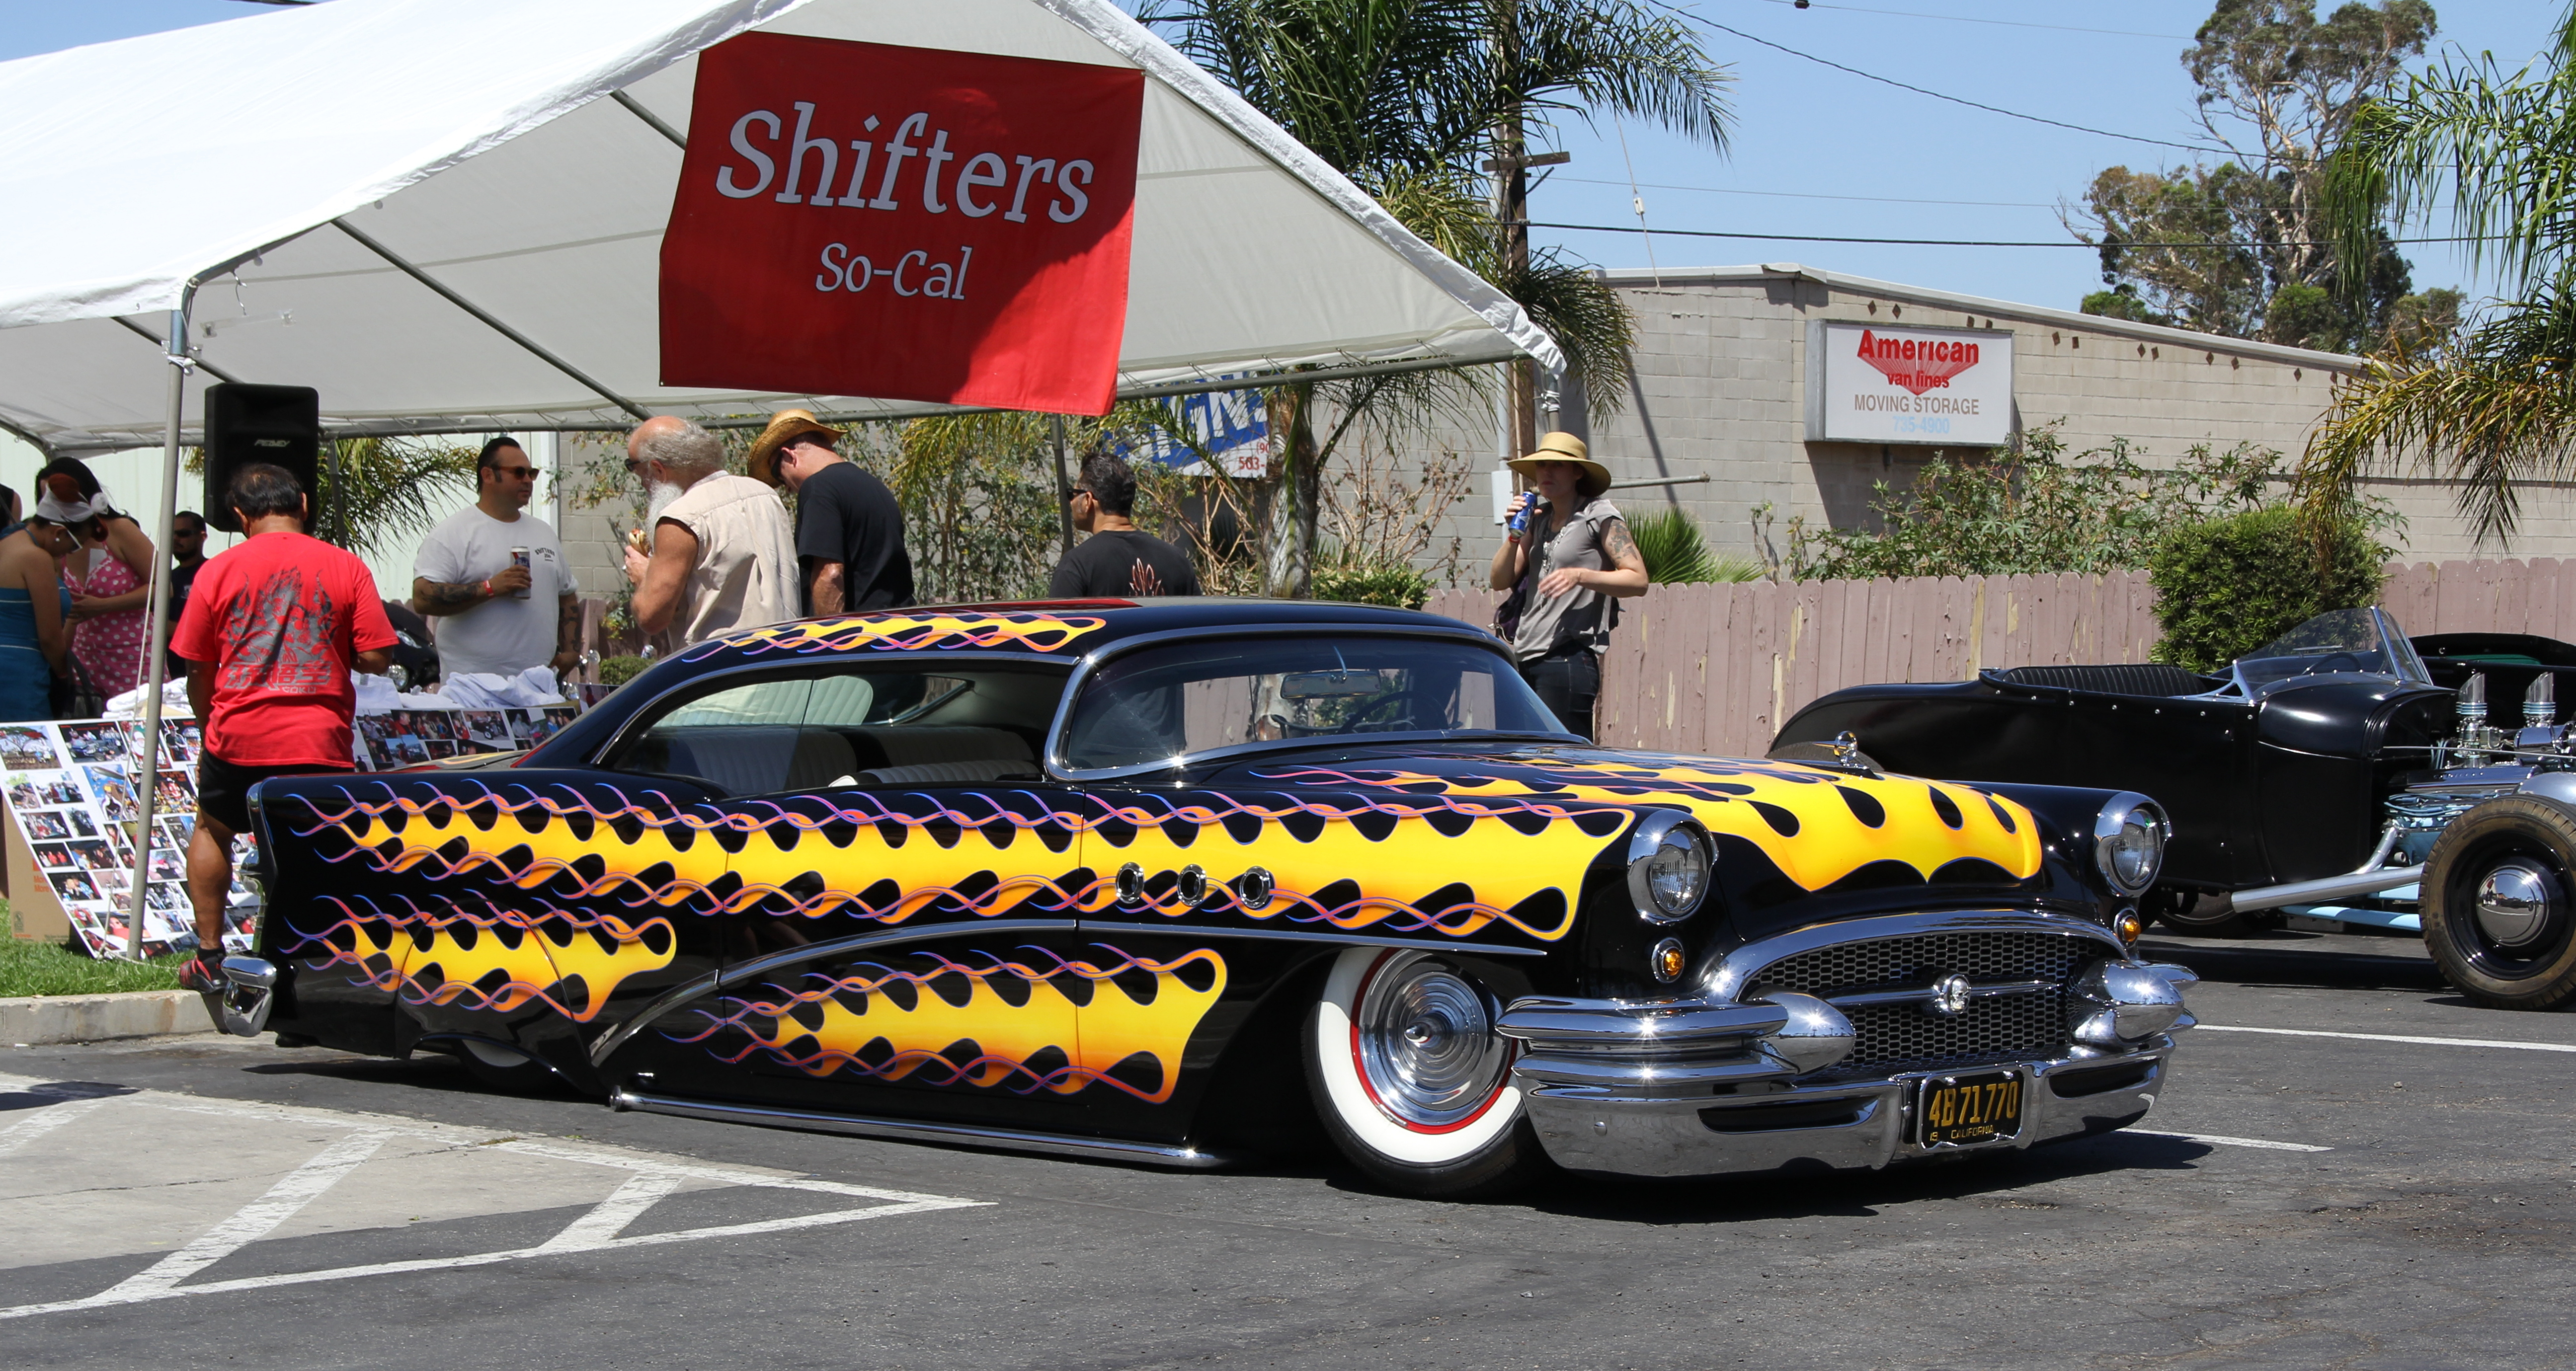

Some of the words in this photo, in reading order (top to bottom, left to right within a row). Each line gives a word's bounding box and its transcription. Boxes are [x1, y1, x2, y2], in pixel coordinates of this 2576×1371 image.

[715, 100, 1095, 224] Shifters
[814, 242, 974, 301] So-Cal
[1857, 329, 1979, 363] American
[1887, 373, 1912, 387] van
[1916, 370, 1949, 389] lines
[1854, 394, 1909, 412] MOVING
[1914, 396, 1979, 415] STORAGE
[1892, 415, 1950, 434] 735-4900
[1950, 1125, 1994, 1139] CALIFORNIA
